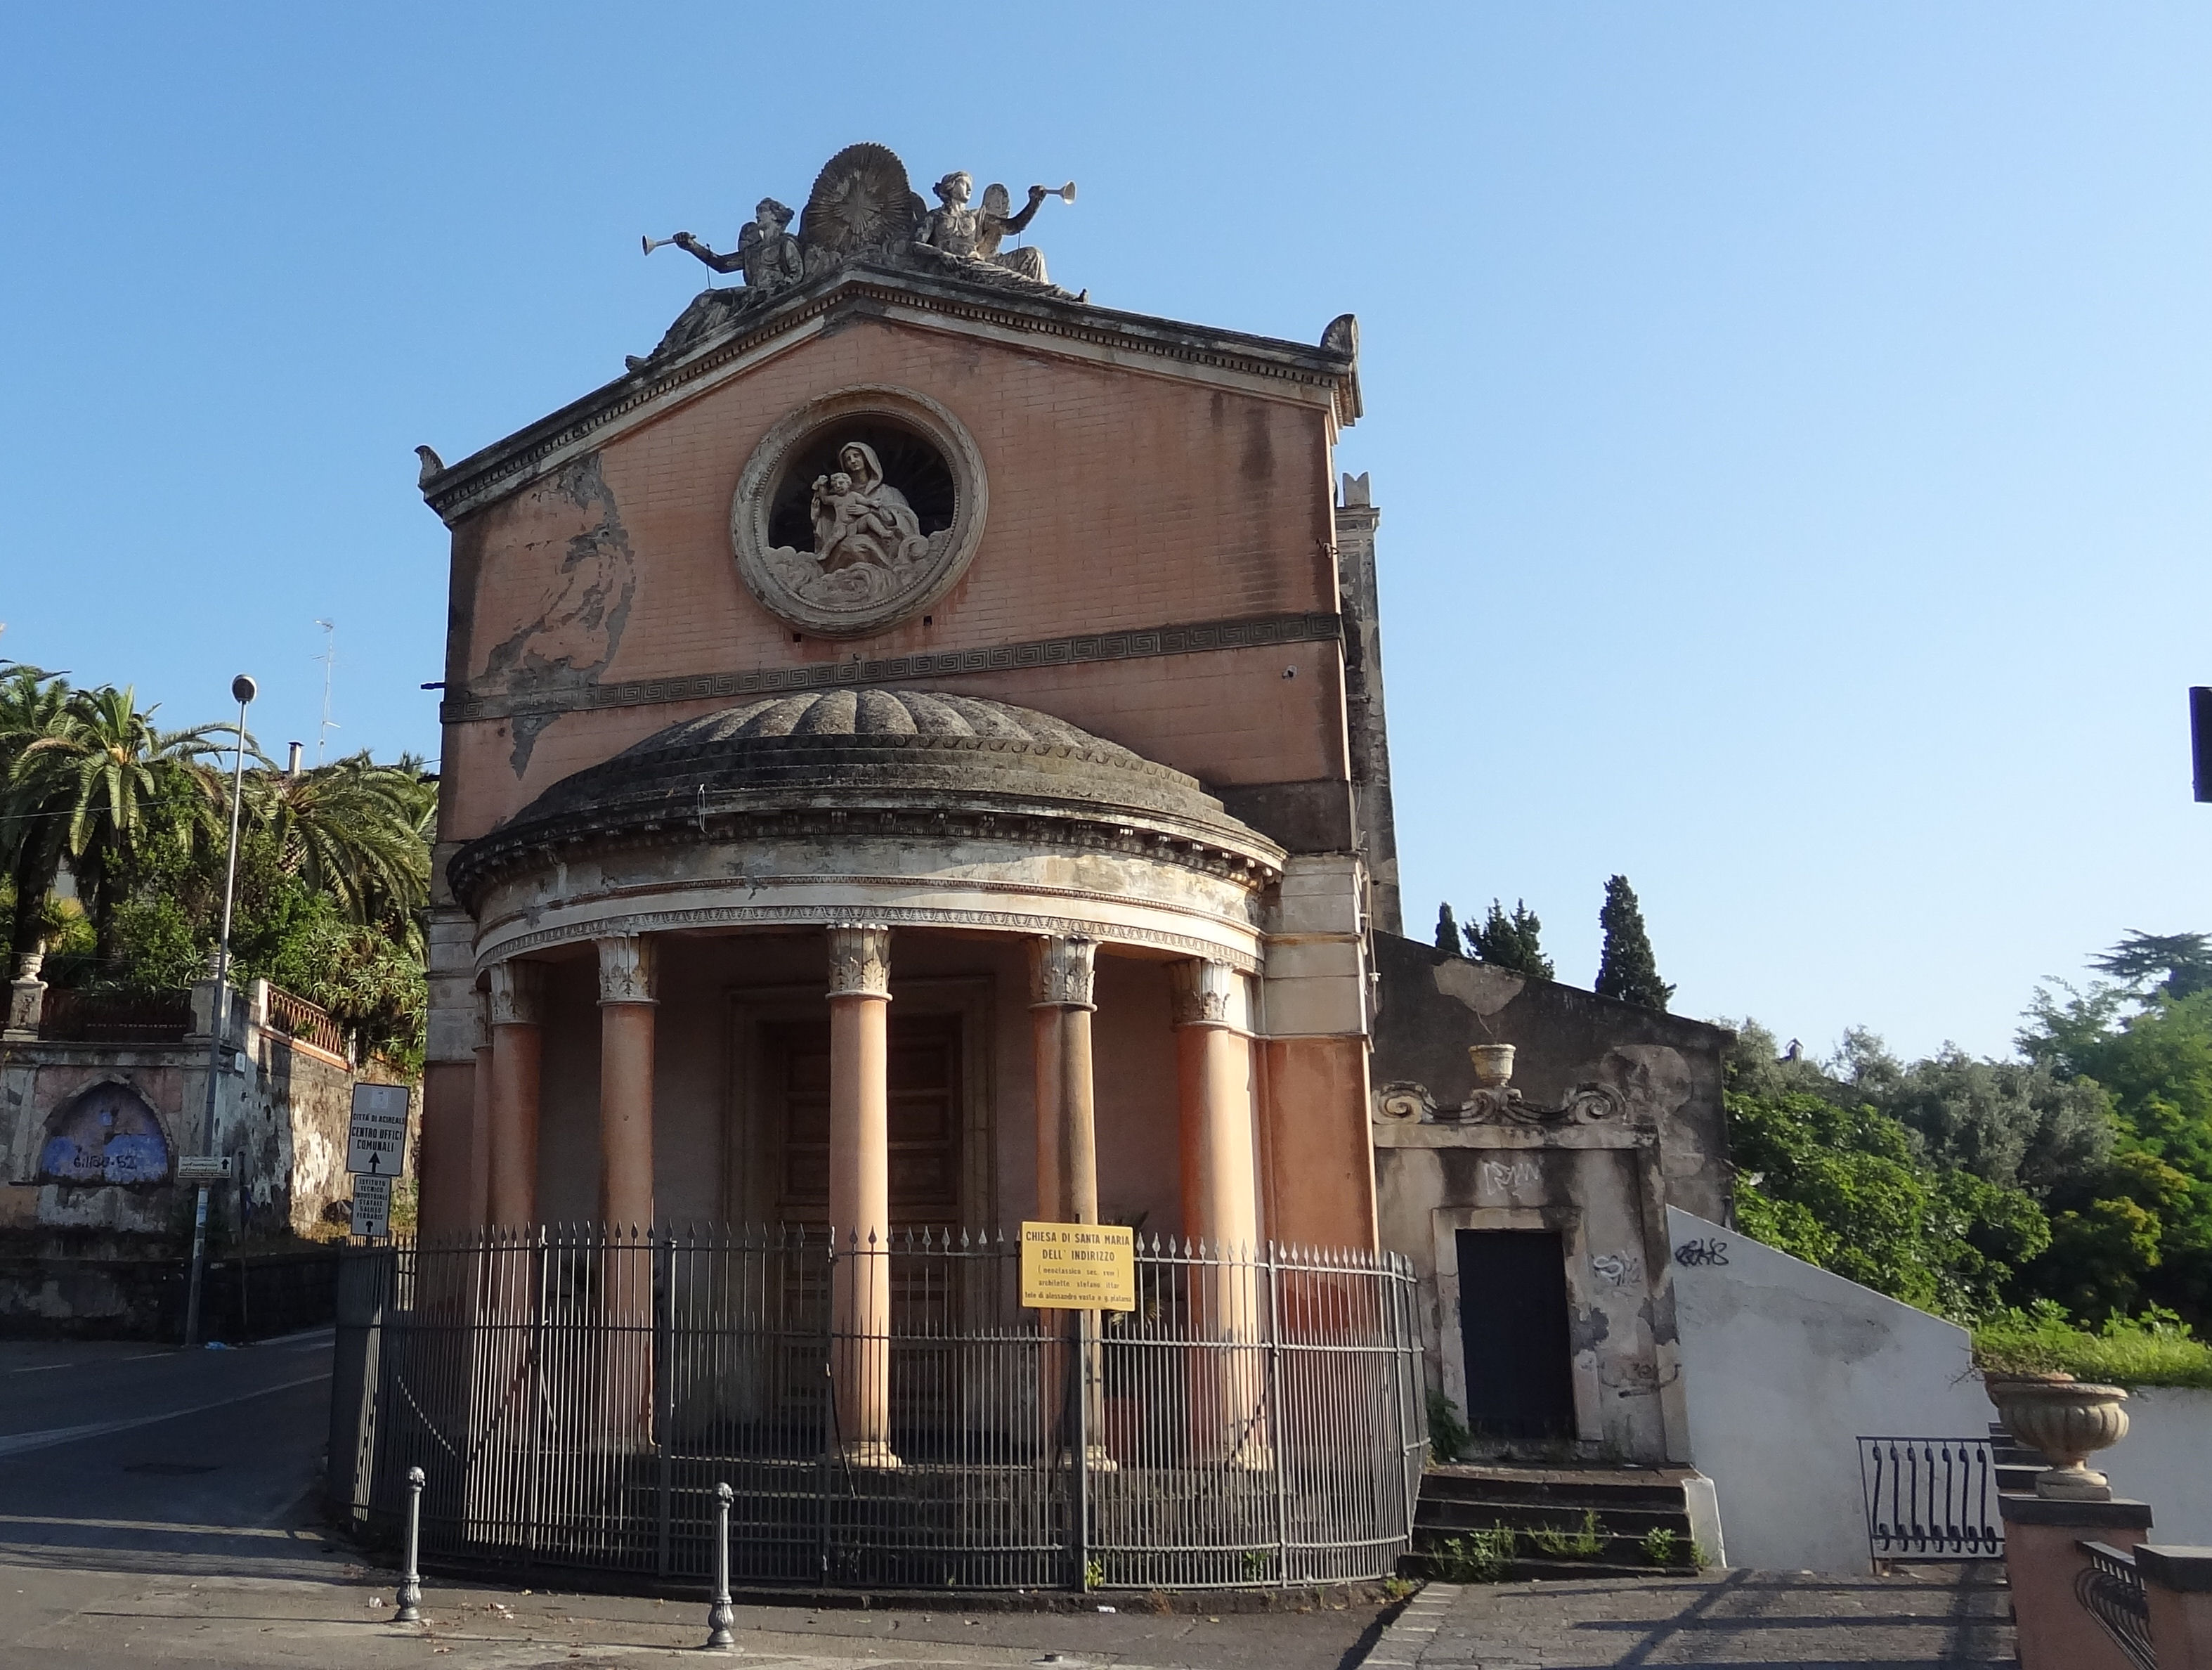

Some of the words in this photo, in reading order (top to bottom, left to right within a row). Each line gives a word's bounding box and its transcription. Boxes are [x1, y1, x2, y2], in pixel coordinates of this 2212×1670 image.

[378, 1115, 405, 1125] ACIREALE
[351, 1127, 377, 1138] CENTRO
[379, 1129, 402, 1140] UFFICI
[357, 1139, 394, 1153] COMUNALI
[359, 1178, 386, 1186] ISTITUTO
[356, 1192, 387, 1200] INDUSTRIALE
[1026, 1231, 1057, 1242] CHIESA
[1062, 1233, 1070, 1243] DI
[1074, 1234, 1100, 1244] SANTA
[1105, 1235, 1130, 1245] MARIA
[1072, 1250, 1115, 1262] INDIRIZZO
[1046, 1292, 1077, 1300] alessandro
